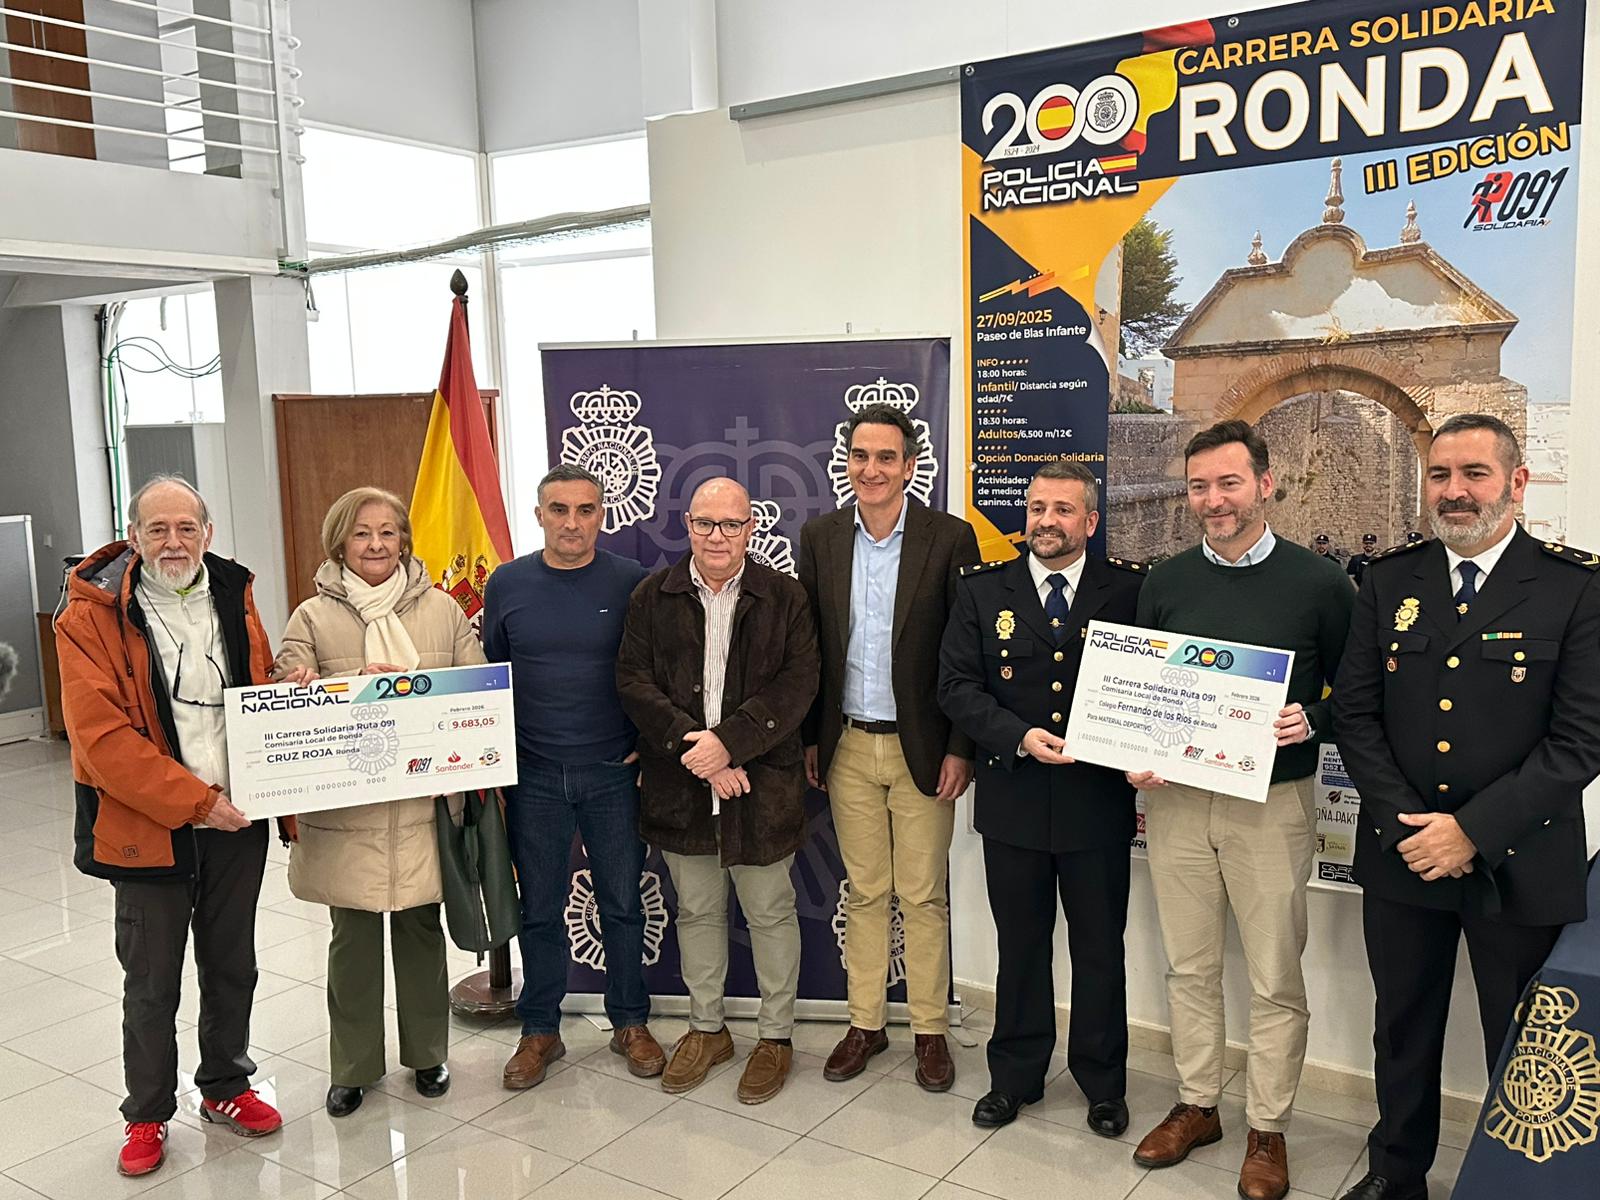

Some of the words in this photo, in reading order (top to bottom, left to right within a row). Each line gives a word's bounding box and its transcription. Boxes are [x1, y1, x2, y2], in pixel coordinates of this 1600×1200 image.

[1177, 27, 1339, 75] CARRERA
[1349, 0, 1556, 48] SOLIDARIA
[1178, 31, 1554, 162] RONDA
[981, 74, 1139, 162] 200
[1364, 160, 1397, 194] III
[1408, 121, 1569, 184] EDICIÓN
[984, 176, 1138, 210] NACIONAL
[1472, 219, 1547, 232] SOLIDARIA
[976, 309, 1053, 328] 27/09/2025
[976, 332, 1007, 342] Paseo
[1009, 330, 1022, 339] de
[1024, 328, 1043, 338] Blas
[1046, 325, 1086, 337] Infante
[977, 359, 998, 367] INFO
[977, 370, 1000, 378] 18:00
[1002, 369, 1027, 377] horas:
[1020, 380, 1057, 391] Distancia
[1059, 379, 1088, 390] según
[977, 394, 1014, 403] edad/7€
[978, 417, 1000, 425] 18:30
[1002, 416, 1028, 424] horas:
[1045, 429, 1073, 438] m/12€
[579, 446, 597, 468] ERPO
[597, 441, 636, 464] NACIONAL
[977, 453, 1012, 463] Opción
[1014, 453, 1058, 462] Donación
[1060, 452, 1105, 462] Solidaria
[977, 476, 1029, 485] Actividades:
[603, 493, 626, 504] LICIA
[977, 487, 990, 495] de
[991, 487, 1022, 495] medios
[1014, 498, 1028, 506] dro
[1089, 638, 1166, 659] NACIONAL
[1183, 644, 1234, 671] 200
[375, 674, 432, 700] 200
[1103, 675, 1111, 683] III
[1112, 676, 1142, 689] Carrera
[1143, 682, 1179, 696] Solidaria
[1180, 689, 1200, 700] Ruta
[1201, 693, 1216, 702] 091
[241, 695, 350, 714] NACIONAL
[1133, 691, 1152, 700] Local
[1162, 696, 1184, 706] Ronda
[1098, 700, 1117, 709] Colegio
[1117, 701, 1152, 716] Fernando
[1152, 709, 1163, 718] de
[1163, 710, 1175, 720] los
[1201, 719, 1218, 729] Ronda
[1228, 708, 1252, 720] 200
[264, 733, 273, 741] III
[276, 729, 311, 739] Carrera
[313, 723, 354, 735] Solidaria
[356, 721, 378, 730] Ruta
[380, 719, 396, 727] 091
[452, 717, 495, 729] 9.683,05
[1098, 715, 1123, 726] MATERIAL
[1123, 721, 1152, 732] DEPORTIVO
[305, 736, 325, 744] Local
[338, 733, 363, 741] Ronda
[266, 752, 299, 763] CRUZ
[302, 748, 334, 759] ROJA
[435, 762, 474, 774] Santander
[1518, 1047, 1569, 1075] NACIONAL
[1565, 1076, 1576, 1091] DE
[1515, 1111, 1558, 1124] POLICIA
